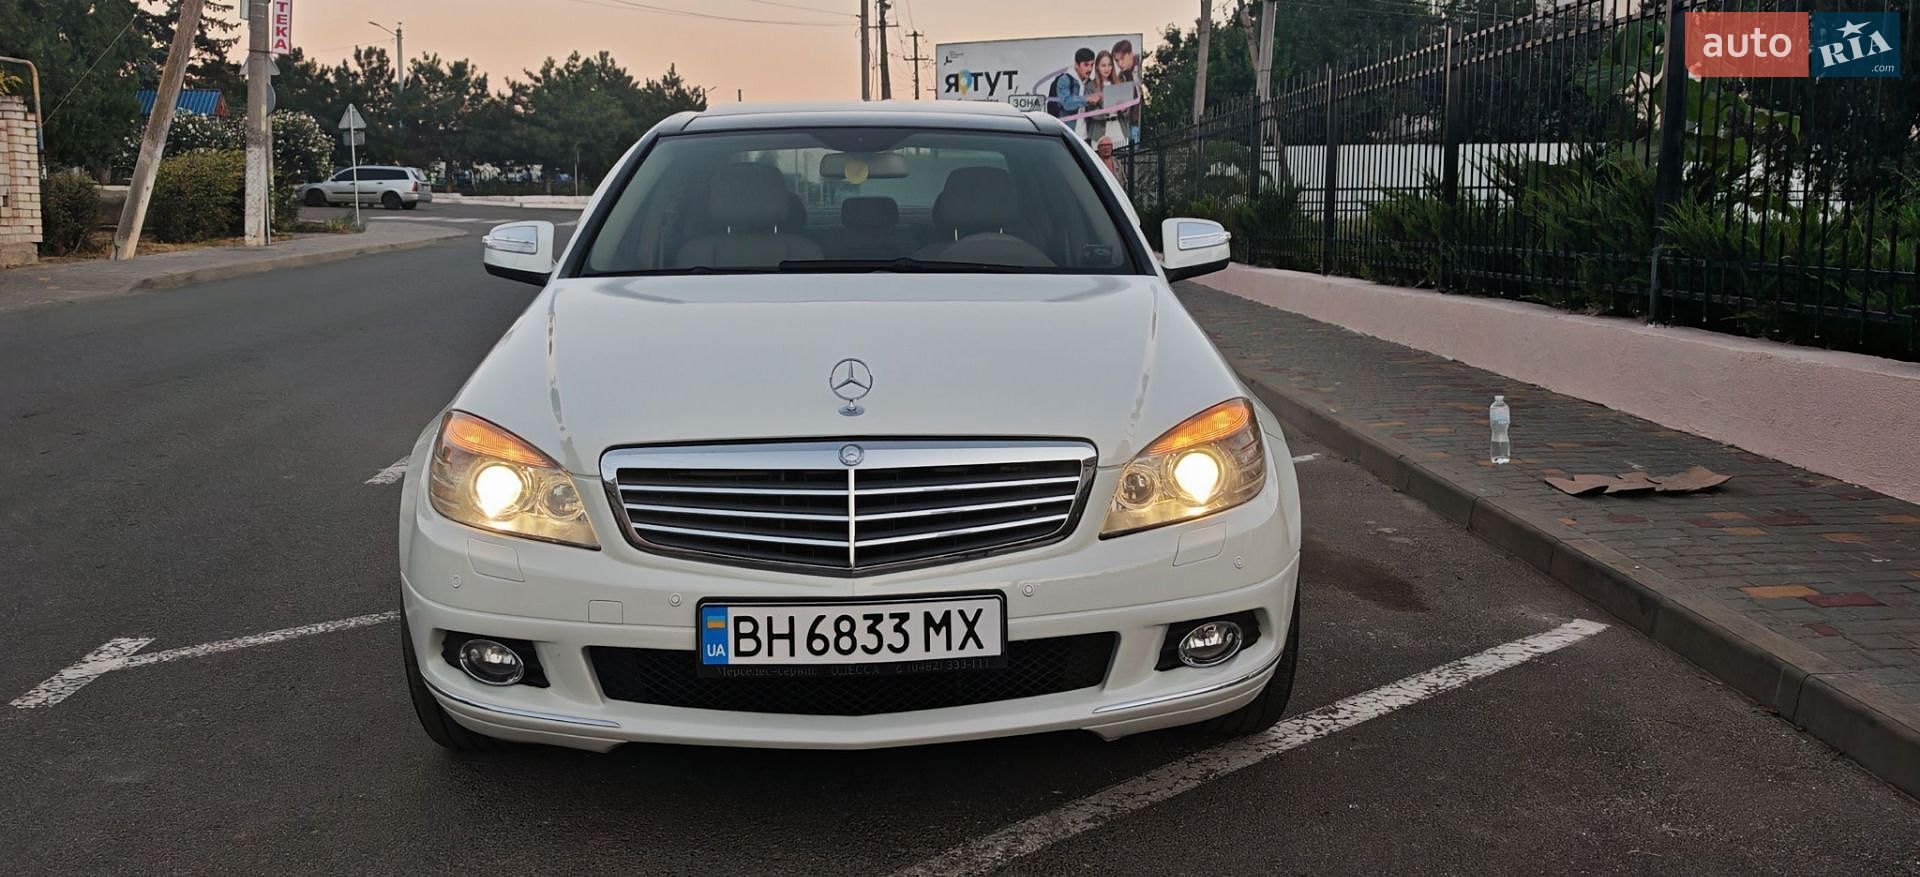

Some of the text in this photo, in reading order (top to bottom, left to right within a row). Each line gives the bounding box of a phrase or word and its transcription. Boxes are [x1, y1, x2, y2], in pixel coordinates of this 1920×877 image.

[274, 0, 289, 50] ТЕКА
[1012, 98, 1041, 108] ЗОНА
[733, 608, 985, 658] BH 6833 MX
[707, 644, 726, 657] UA
